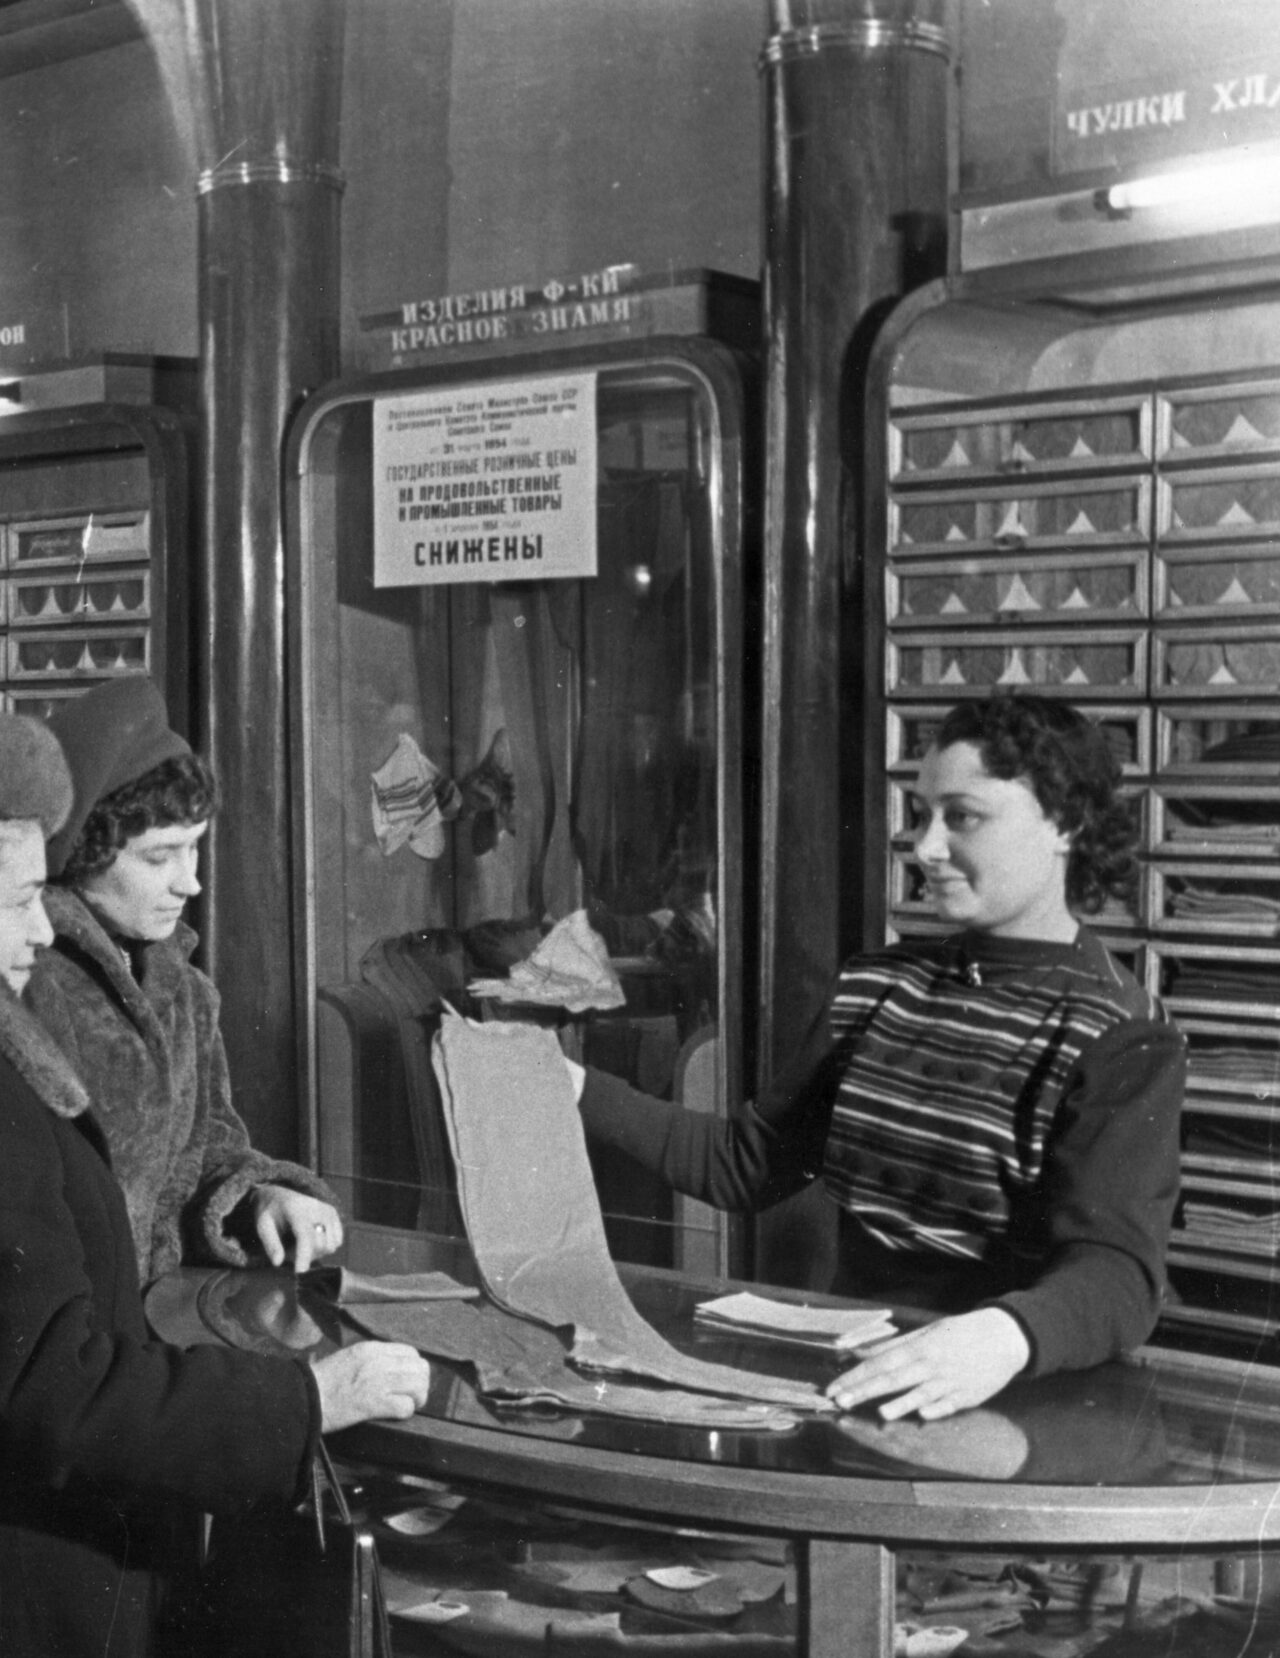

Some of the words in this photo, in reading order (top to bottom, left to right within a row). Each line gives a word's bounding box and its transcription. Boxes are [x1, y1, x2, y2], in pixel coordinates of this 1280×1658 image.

[1067, 91, 1186, 138] ЧУЛКИ
[402, 286, 526, 325] ИЗДЕЛИЯ
[543, 269, 619, 302] Ф-КИ
[391, 316, 508, 351] КРАСНОЕ
[386, 457, 480, 483] ГОСУДАРСТВЕННЫЕ
[484, 451, 542, 474] РОЗНИЧНЫЕ
[546, 448, 577, 470] ЦЕНЫ
[398, 487, 415, 504] НА
[420, 473, 562, 503] ПРОДОВОЛЬСТВЕННЫЕ
[398, 507, 407, 522] И
[409, 498, 507, 521] ПРОМЫШЛЕННЫЕ
[512, 493, 563, 514] ТОВАРЫ
[414, 533, 543, 567] СНИЖЕНЫ
